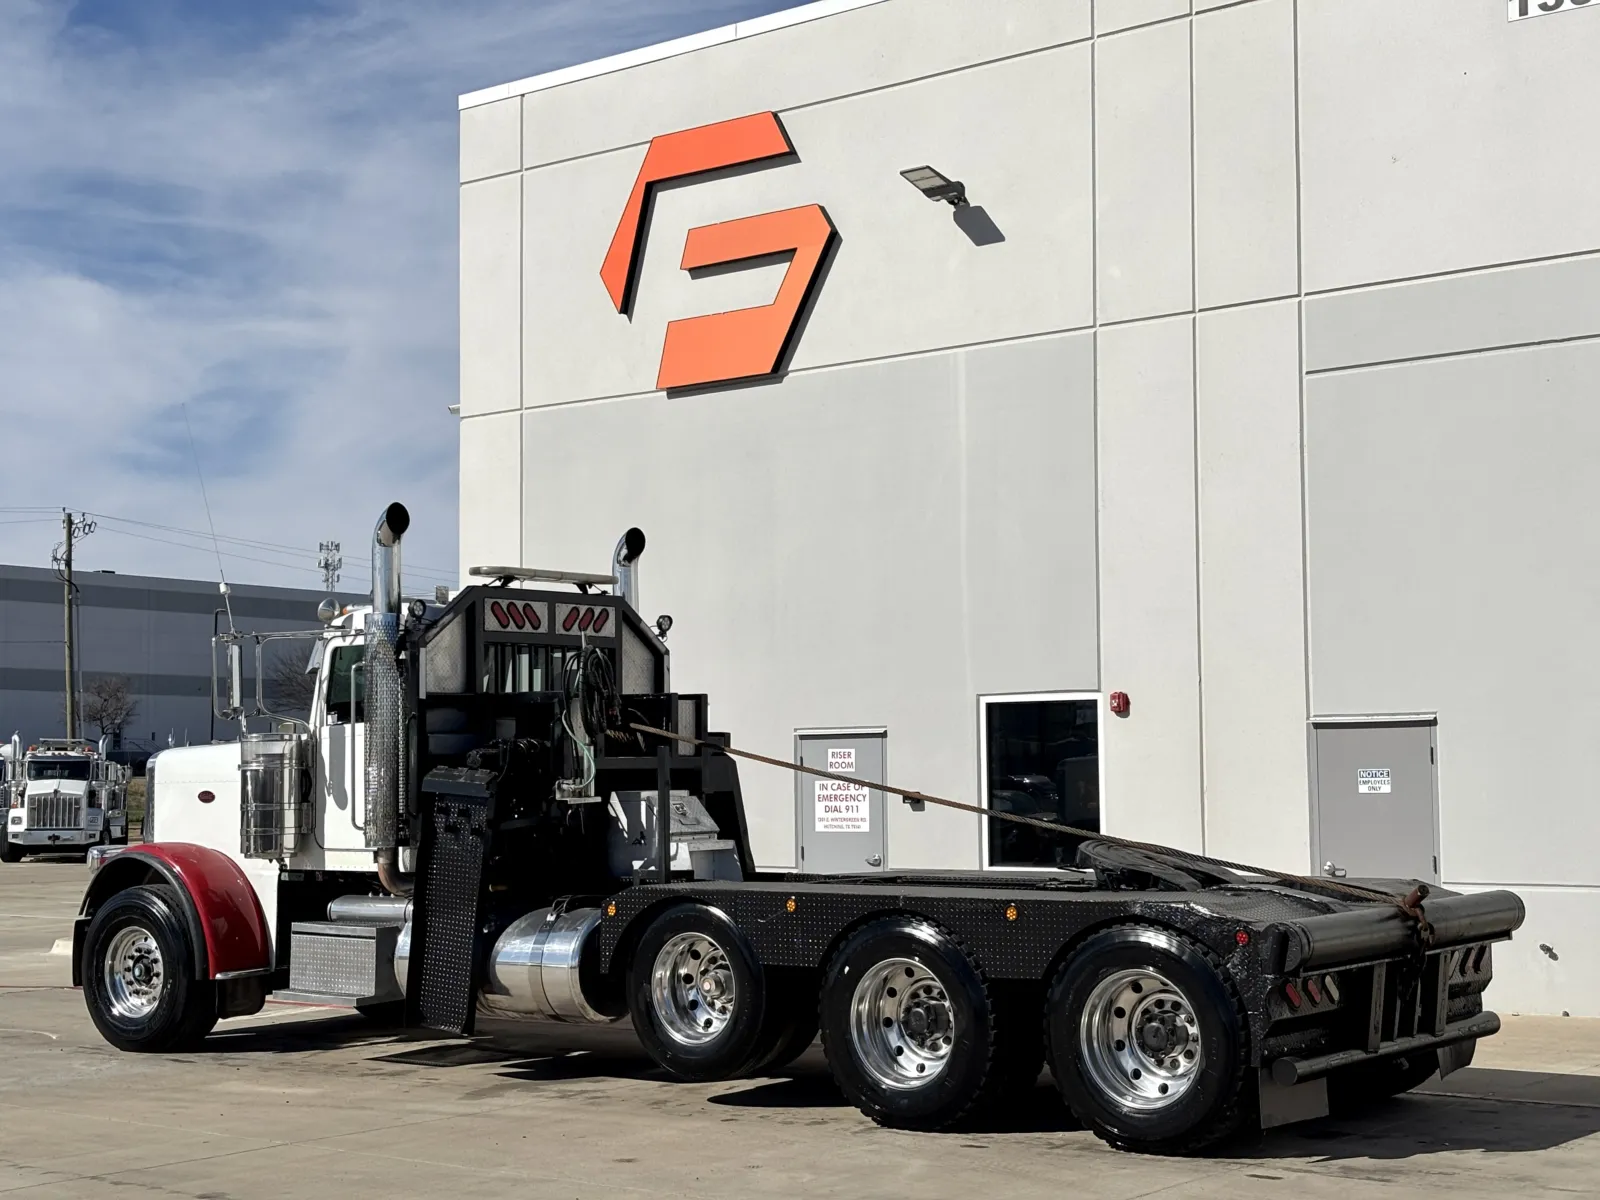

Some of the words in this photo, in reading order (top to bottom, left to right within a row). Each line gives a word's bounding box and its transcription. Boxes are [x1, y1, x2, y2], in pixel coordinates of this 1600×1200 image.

[831, 751, 852, 759] RISER
[829, 761, 853, 769] ROOM
[1360, 770, 1389, 778] NOTICE
[819, 783, 828, 791] IN
[830, 783, 851, 791] CASE
[817, 794, 867, 802] EMERGENCY
[824, 805, 843, 813] DIAL
[845, 805, 859, 813] 911
